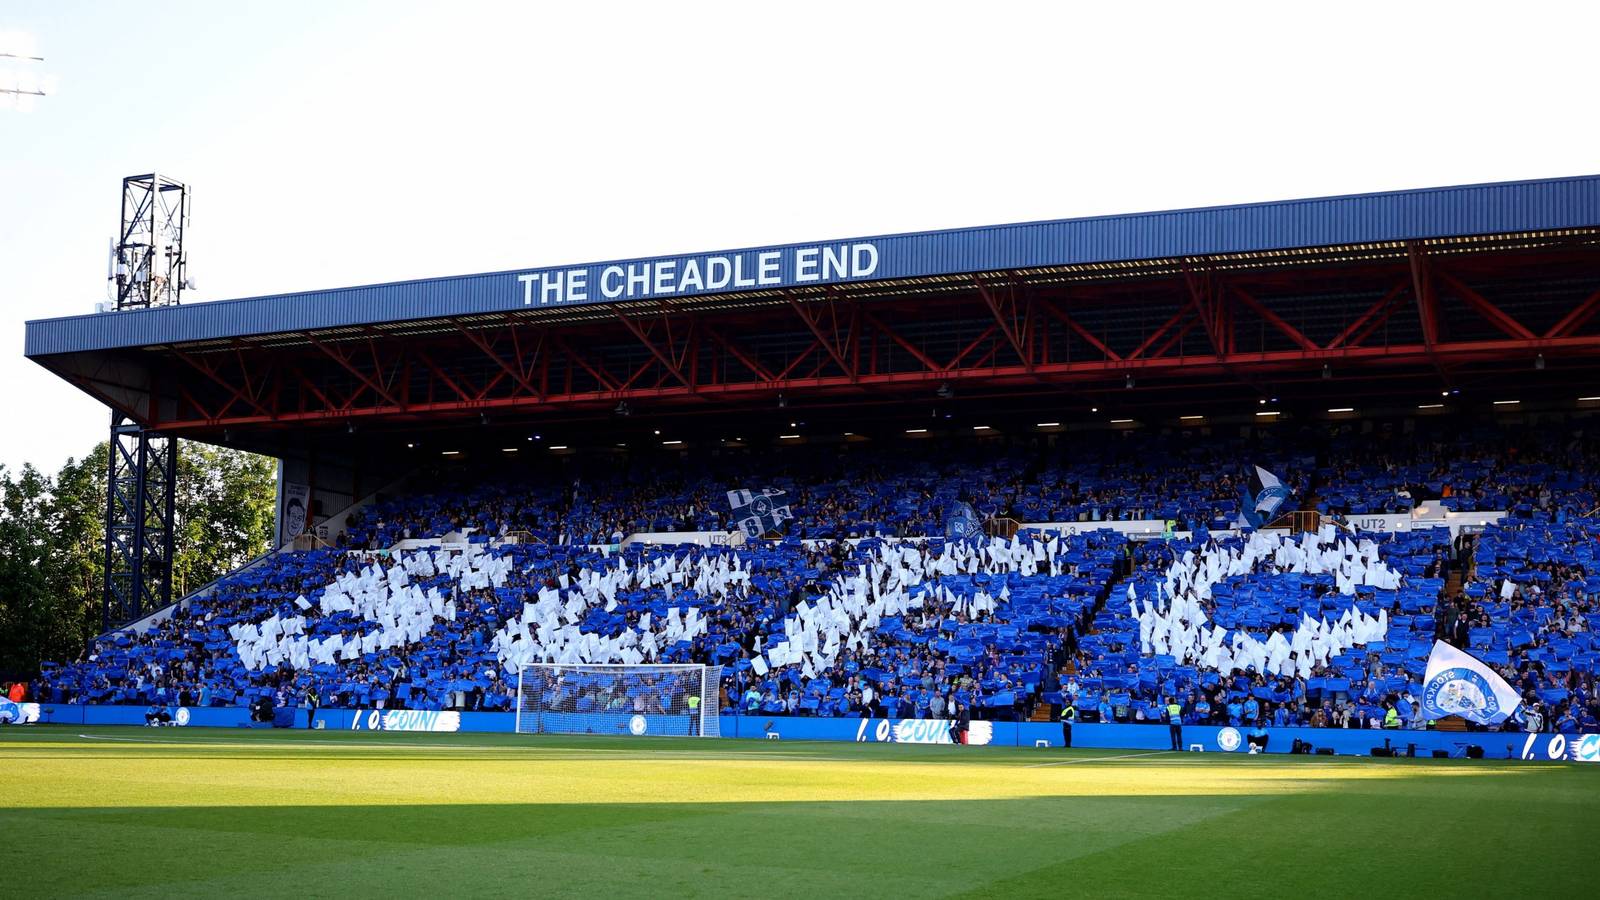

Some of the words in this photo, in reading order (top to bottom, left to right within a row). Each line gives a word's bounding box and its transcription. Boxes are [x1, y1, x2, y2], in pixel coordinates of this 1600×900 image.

[518, 269, 588, 304] THE
[600, 252, 781, 298] CHEADLE
[796, 243, 879, 282] END
[1361, 518, 1386, 529] UT2
